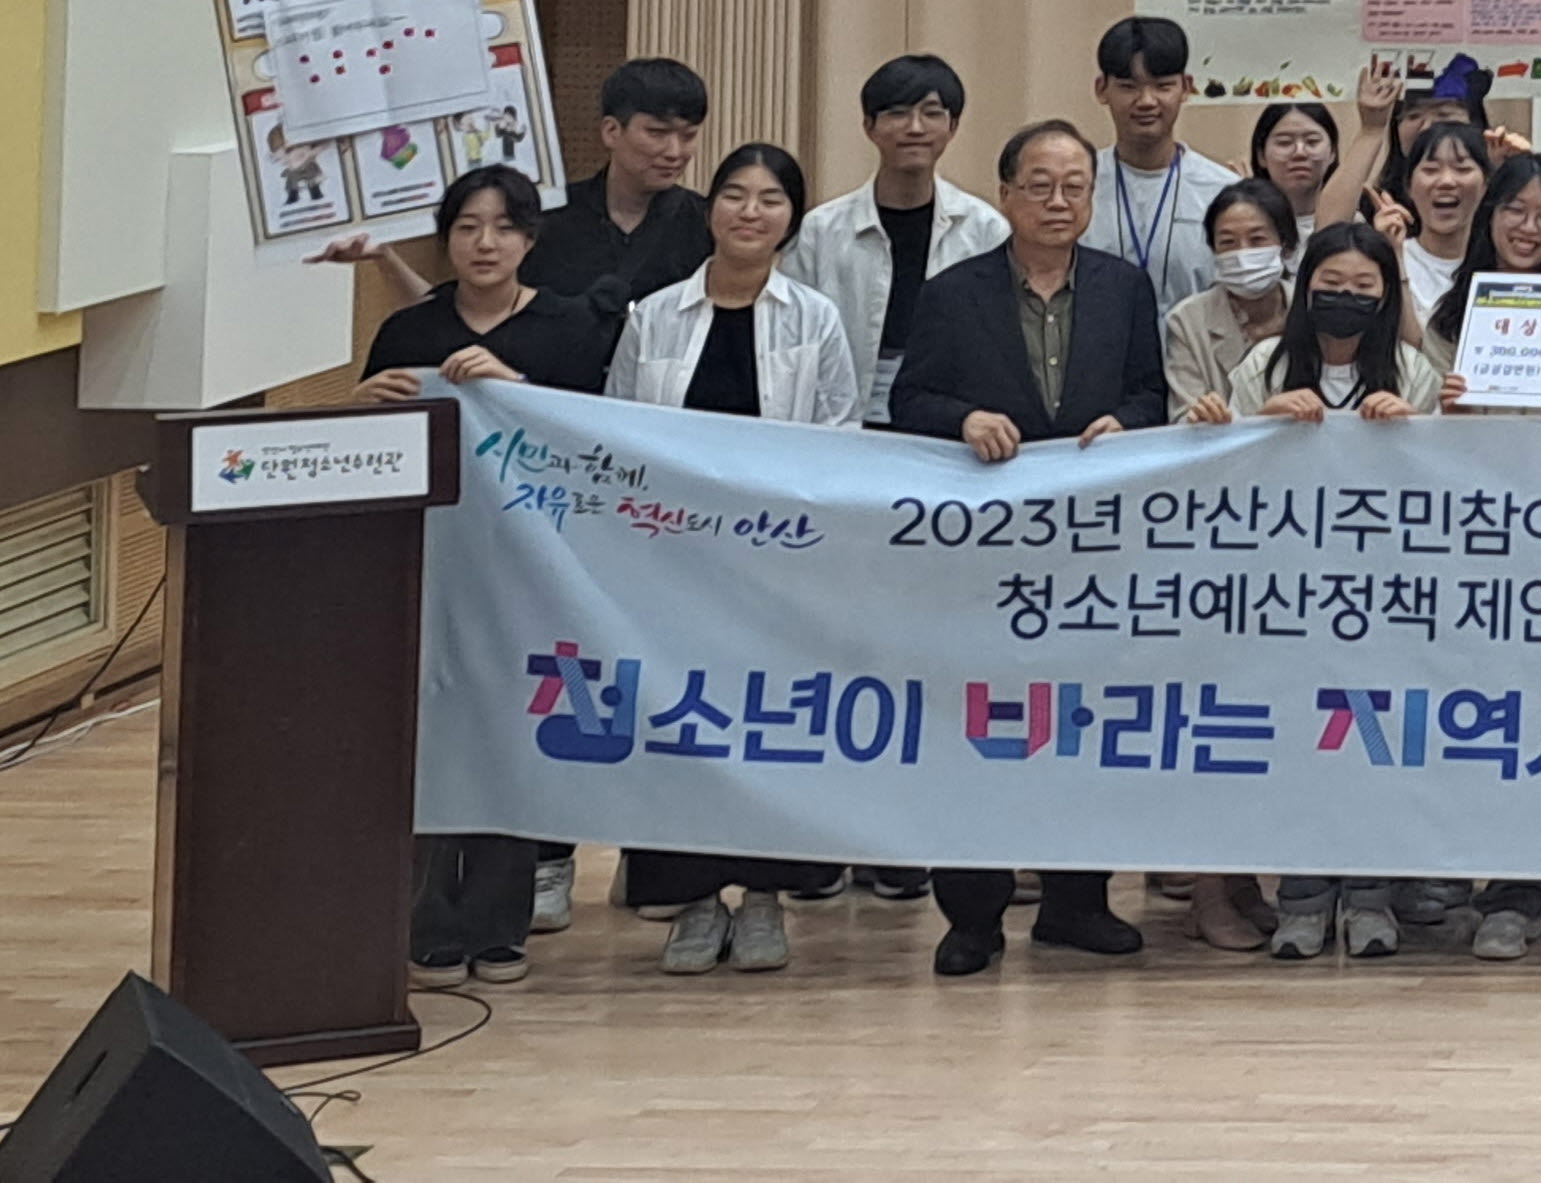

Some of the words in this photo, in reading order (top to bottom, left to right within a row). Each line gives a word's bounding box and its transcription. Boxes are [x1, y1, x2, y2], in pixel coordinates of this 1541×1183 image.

[261, 451, 403, 481] 단원청소년수련관
[475, 428, 570, 482] 시민과
[579, 444, 648, 490] 함께,
[503, 483, 605, 533] 자유로운
[617, 497, 722, 539] 혁신도시
[733, 510, 824, 548] 안산
[888, 494, 1122, 554] 2023년
[995, 572, 1439, 642] 청소년예산정책
[526, 641, 924, 765] 청소년이
[964, 680, 1276, 775] 바라는
